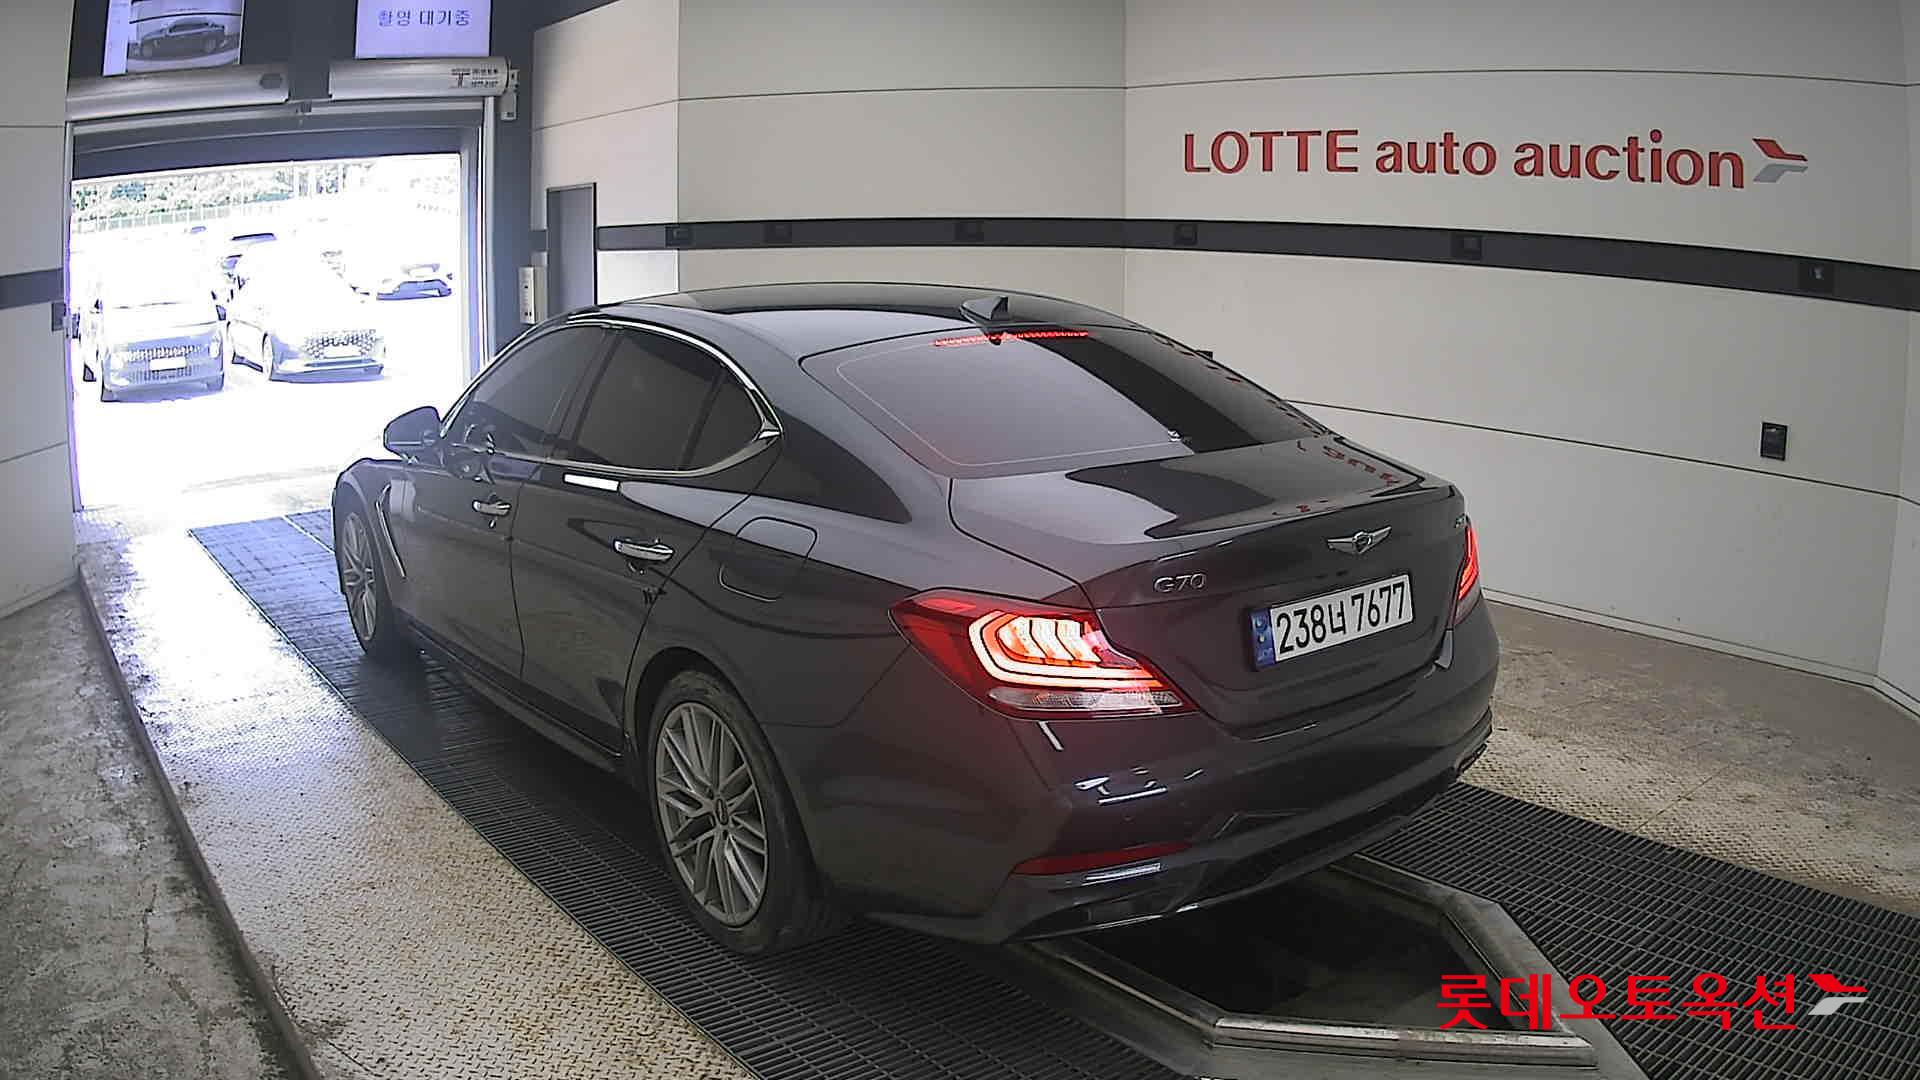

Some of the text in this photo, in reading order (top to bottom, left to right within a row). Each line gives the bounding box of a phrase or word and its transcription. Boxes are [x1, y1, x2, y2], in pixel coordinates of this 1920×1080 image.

[419, 9, 470, 26] 대기중
[1185, 130, 1745, 188] LOTTE auto auction
[1153, 573, 1207, 594] G70
[1276, 581, 1405, 655] 238너 7677
